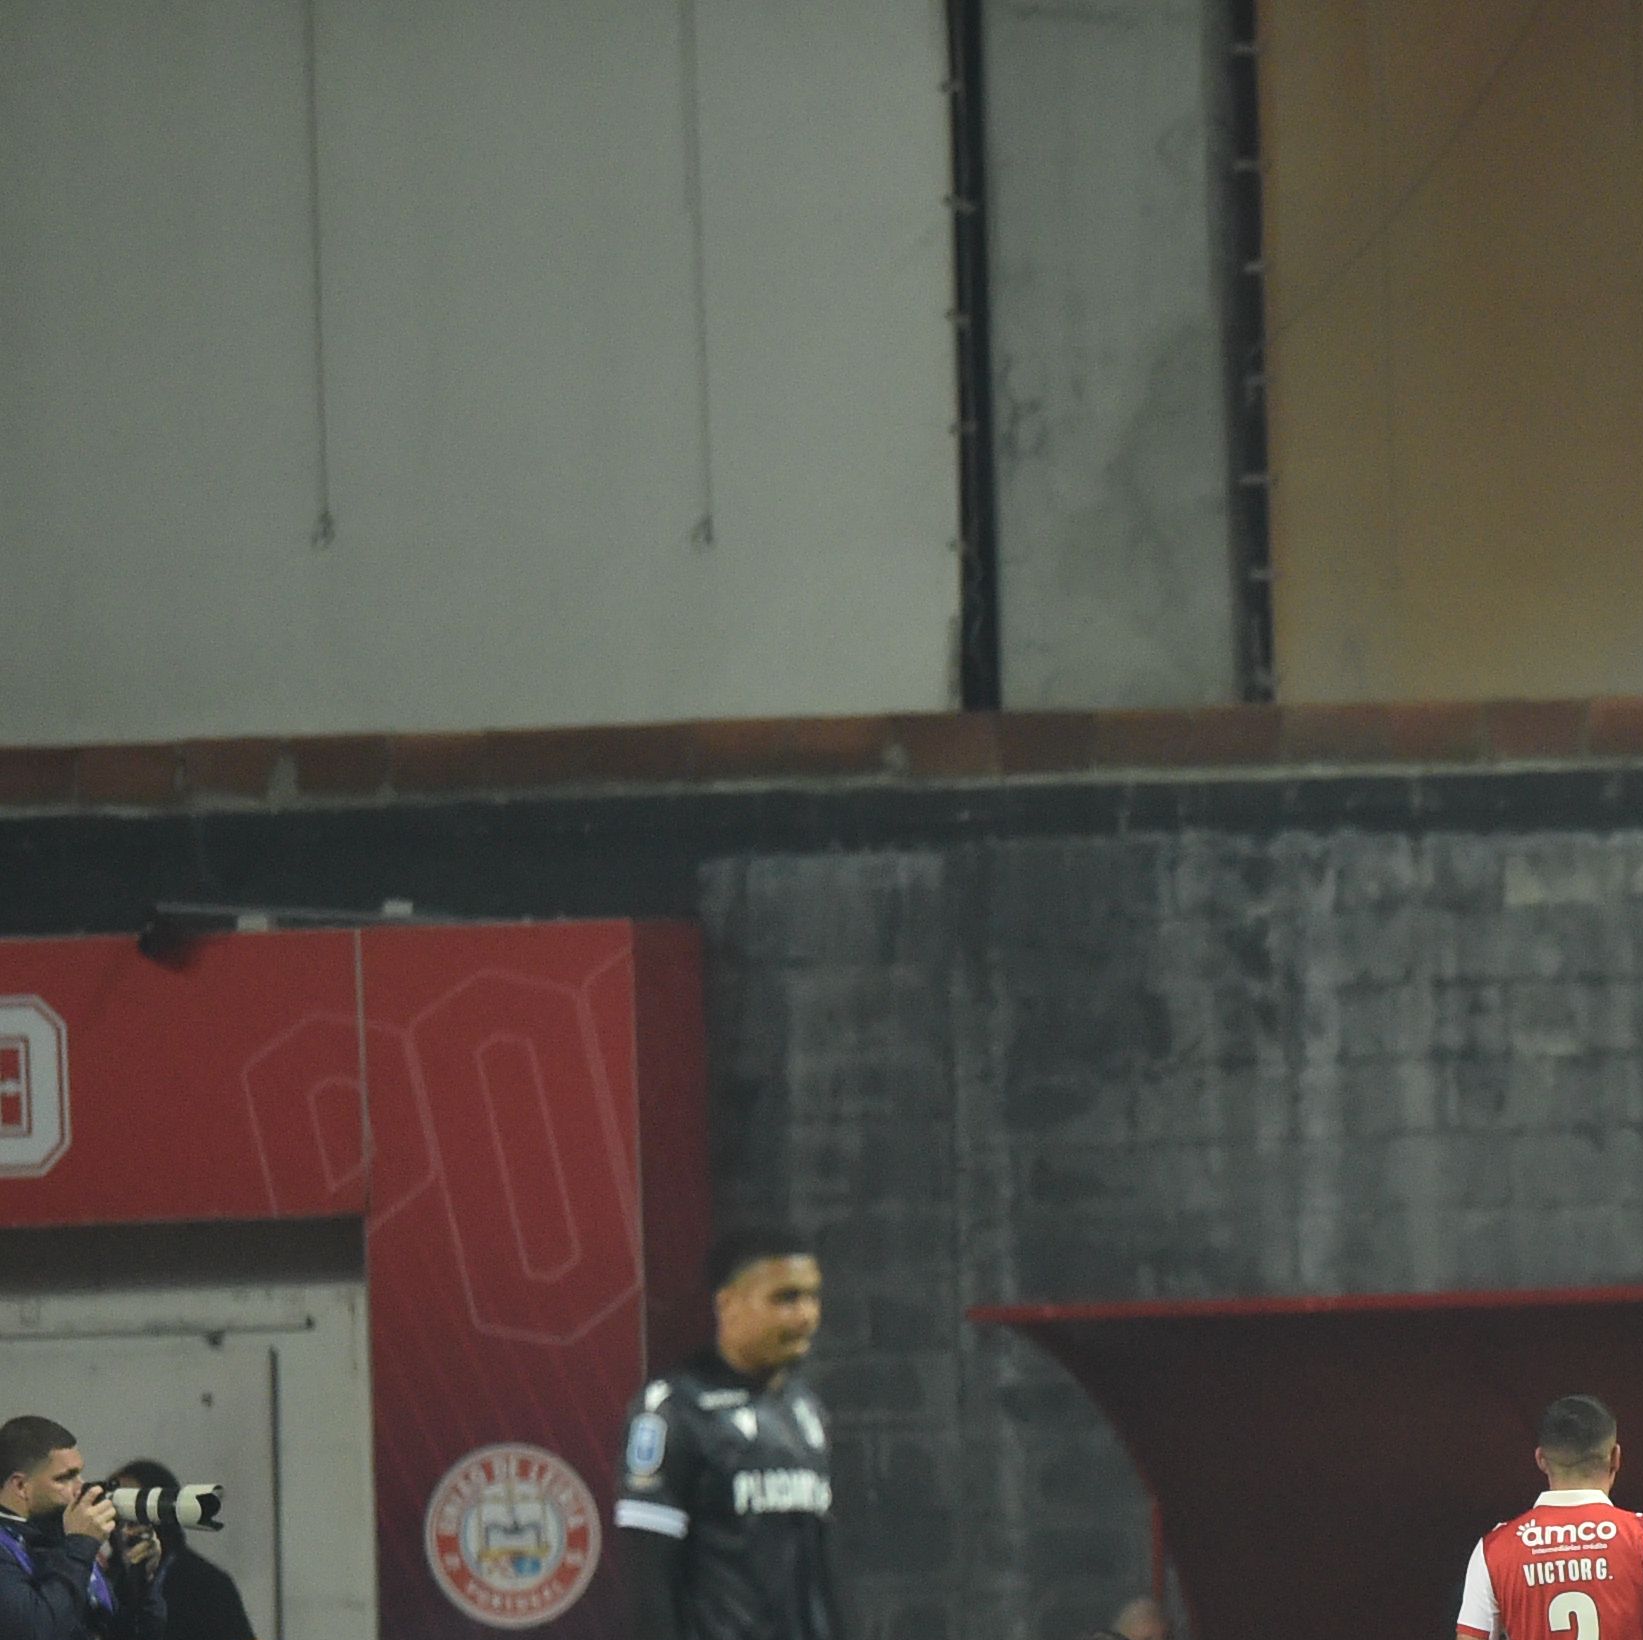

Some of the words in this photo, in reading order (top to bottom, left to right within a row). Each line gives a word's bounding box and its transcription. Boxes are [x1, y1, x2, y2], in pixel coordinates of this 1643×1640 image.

[1516, 1519, 1617, 1547] amco
[1522, 1557, 1593, 1587] VICTOR
[1595, 1556, 1614, 1581] G.
